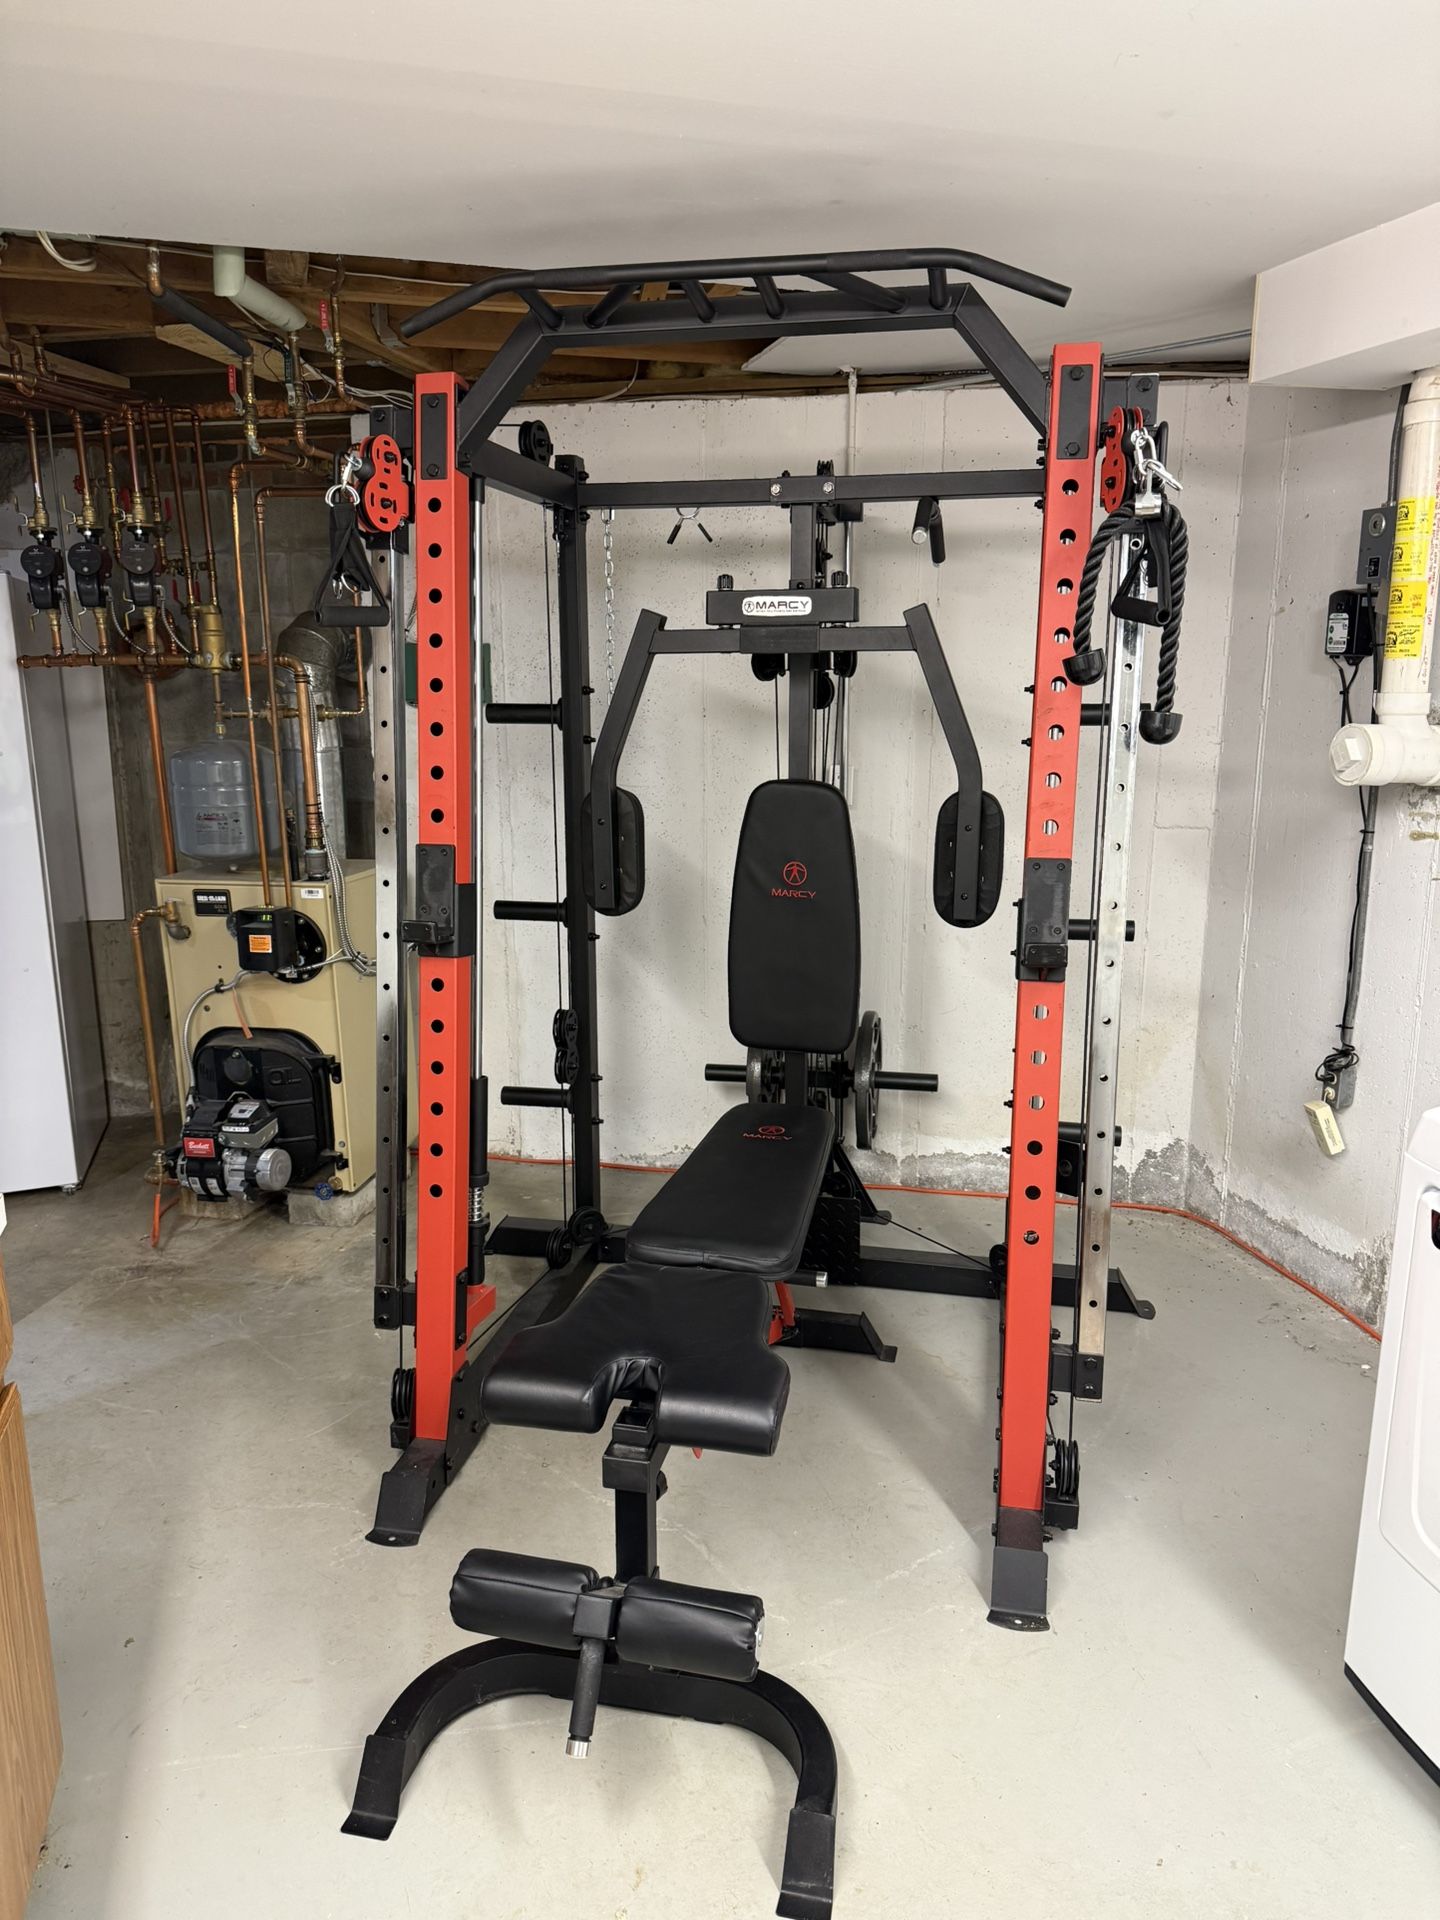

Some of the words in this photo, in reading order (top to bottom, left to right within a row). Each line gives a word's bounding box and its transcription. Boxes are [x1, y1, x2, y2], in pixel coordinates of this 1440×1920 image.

[756, 601, 809, 609] MARCY
[771, 888, 816, 898] MARCY
[743, 1133, 792, 1141] MARCY
